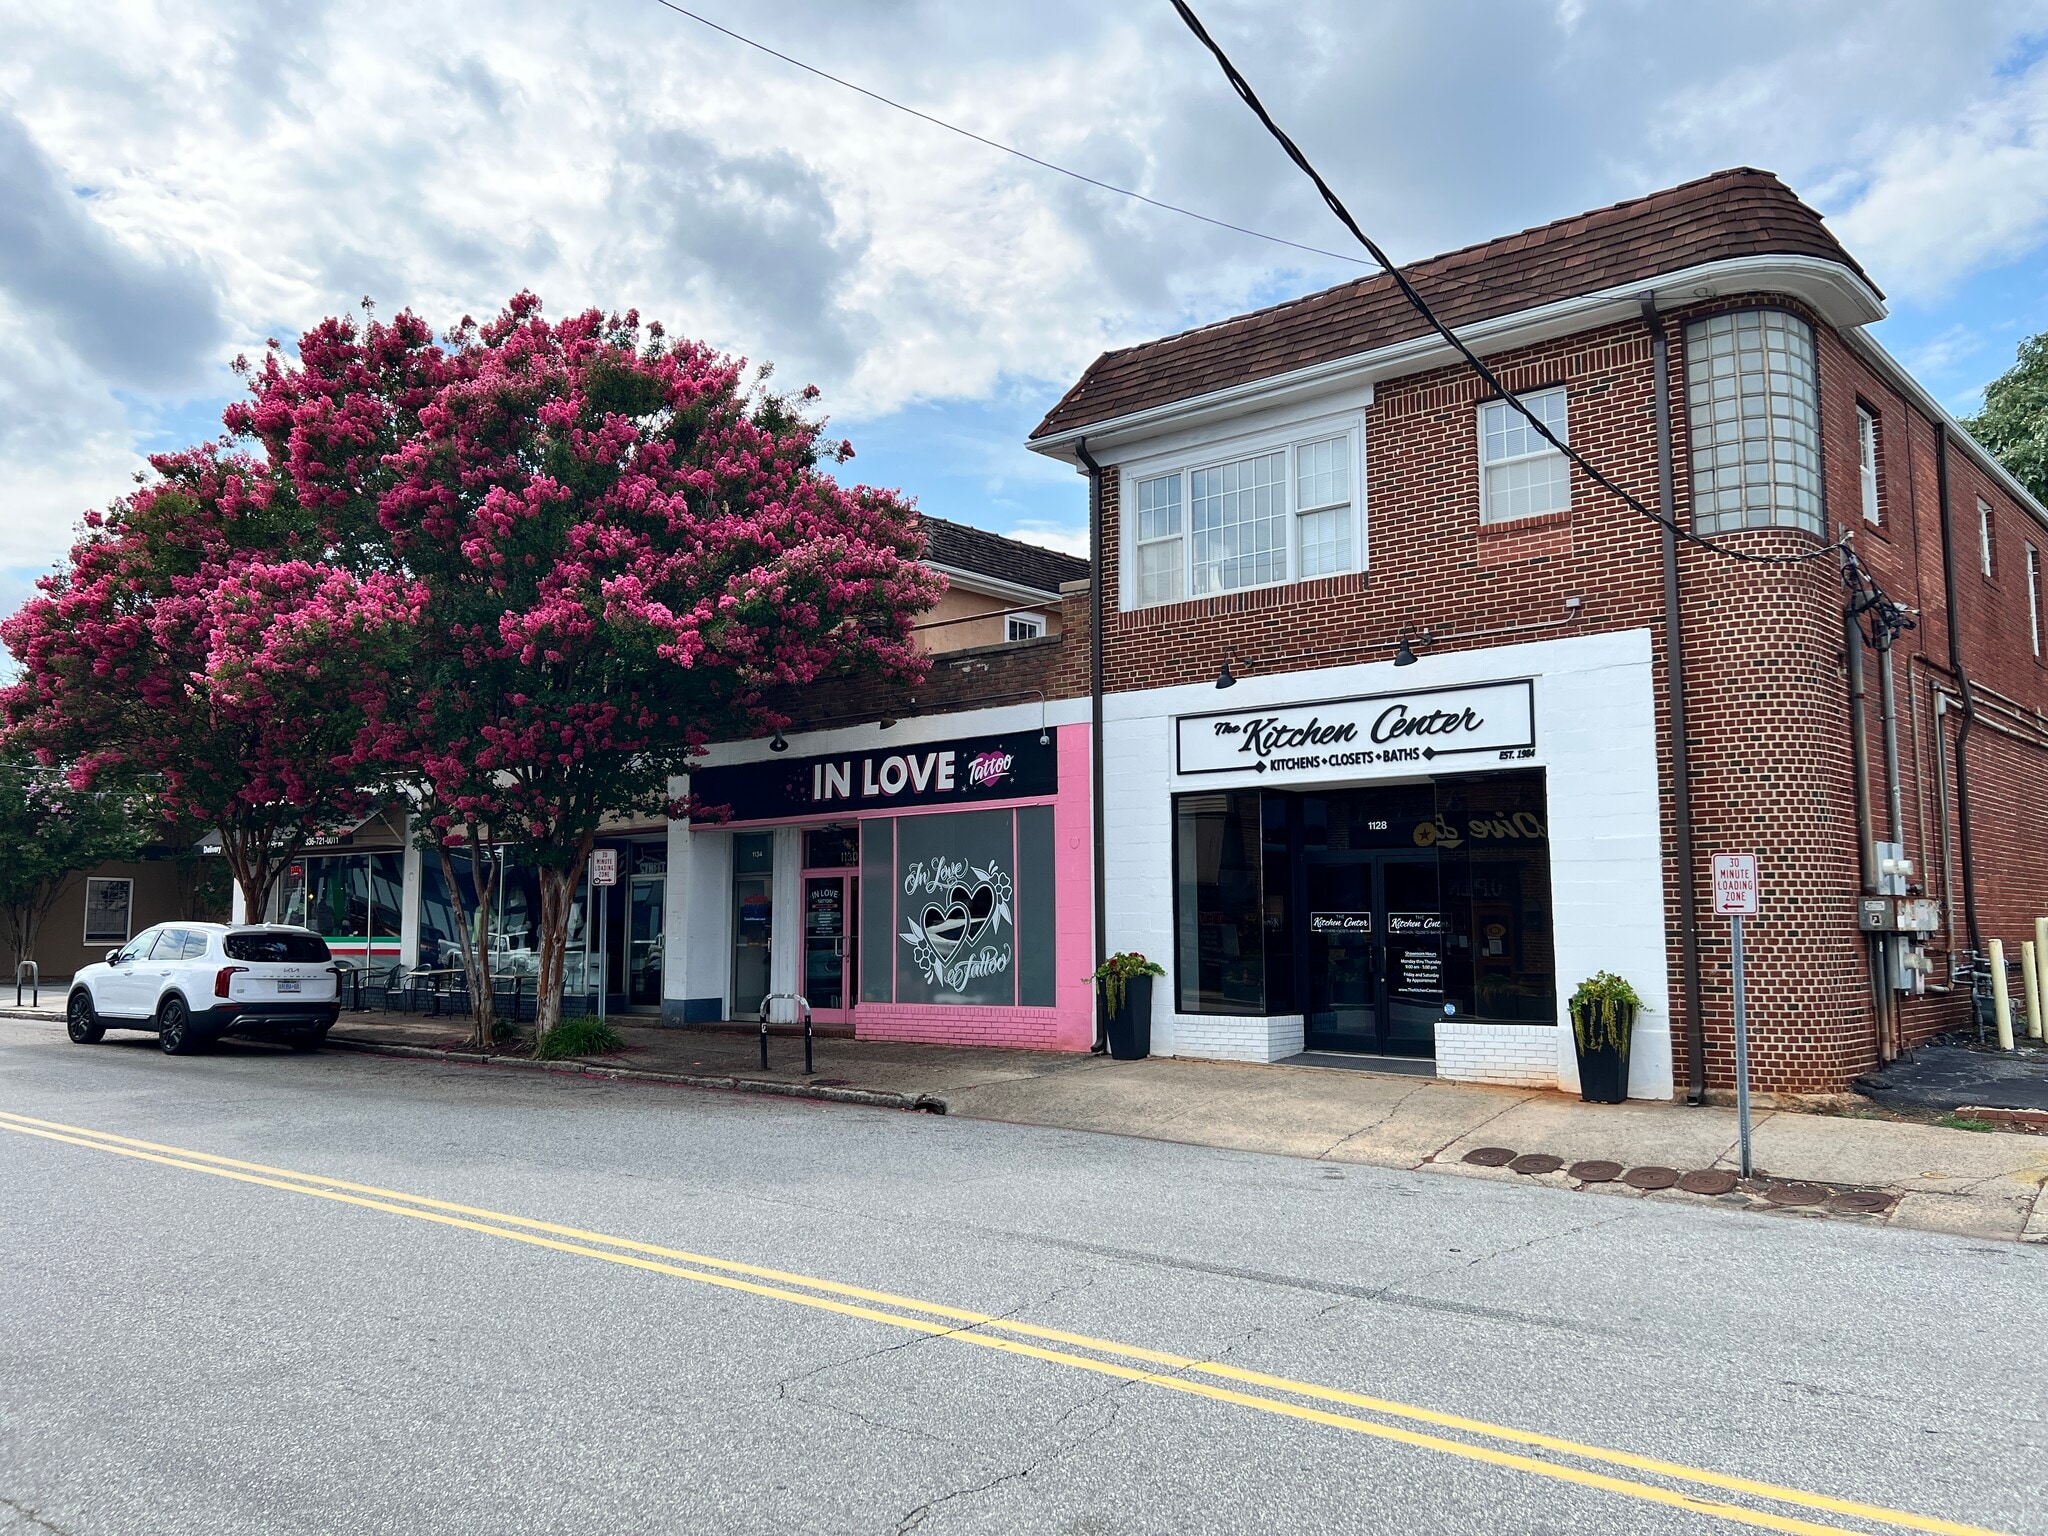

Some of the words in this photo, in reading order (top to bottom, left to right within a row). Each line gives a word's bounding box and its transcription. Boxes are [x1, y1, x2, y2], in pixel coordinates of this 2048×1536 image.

[1214, 721, 1241, 735] The
[1237, 717, 1359, 757] Kitchen
[1370, 704, 1485, 744] Center
[1269, 757, 1321, 772] KITCHENS
[1328, 751, 1374, 767] CLOSETS
[1382, 747, 1420, 763] BATHS
[1499, 751, 1514, 759] EST.
[968, 754, 1015, 785] Tattoo
[812, 762, 851, 802] IN
[862, 751, 956, 798] LOVE
[1367, 820, 1388, 830] 1128
[203, 845, 222, 854] Delivery
[1729, 858, 1740, 867] 30
[926, 856, 969, 894] Love
[1720, 869, 1750, 879] MINUTE
[1717, 881, 1753, 890] LOADING
[812, 891, 820, 899] IN
[820, 889, 839, 898] LOVE
[1725, 892, 1746, 901] ZONE
[1313, 917, 1342, 928] Kitchen
[1343, 917, 1369, 928] Center
[1391, 918, 1422, 929] Kitchen
